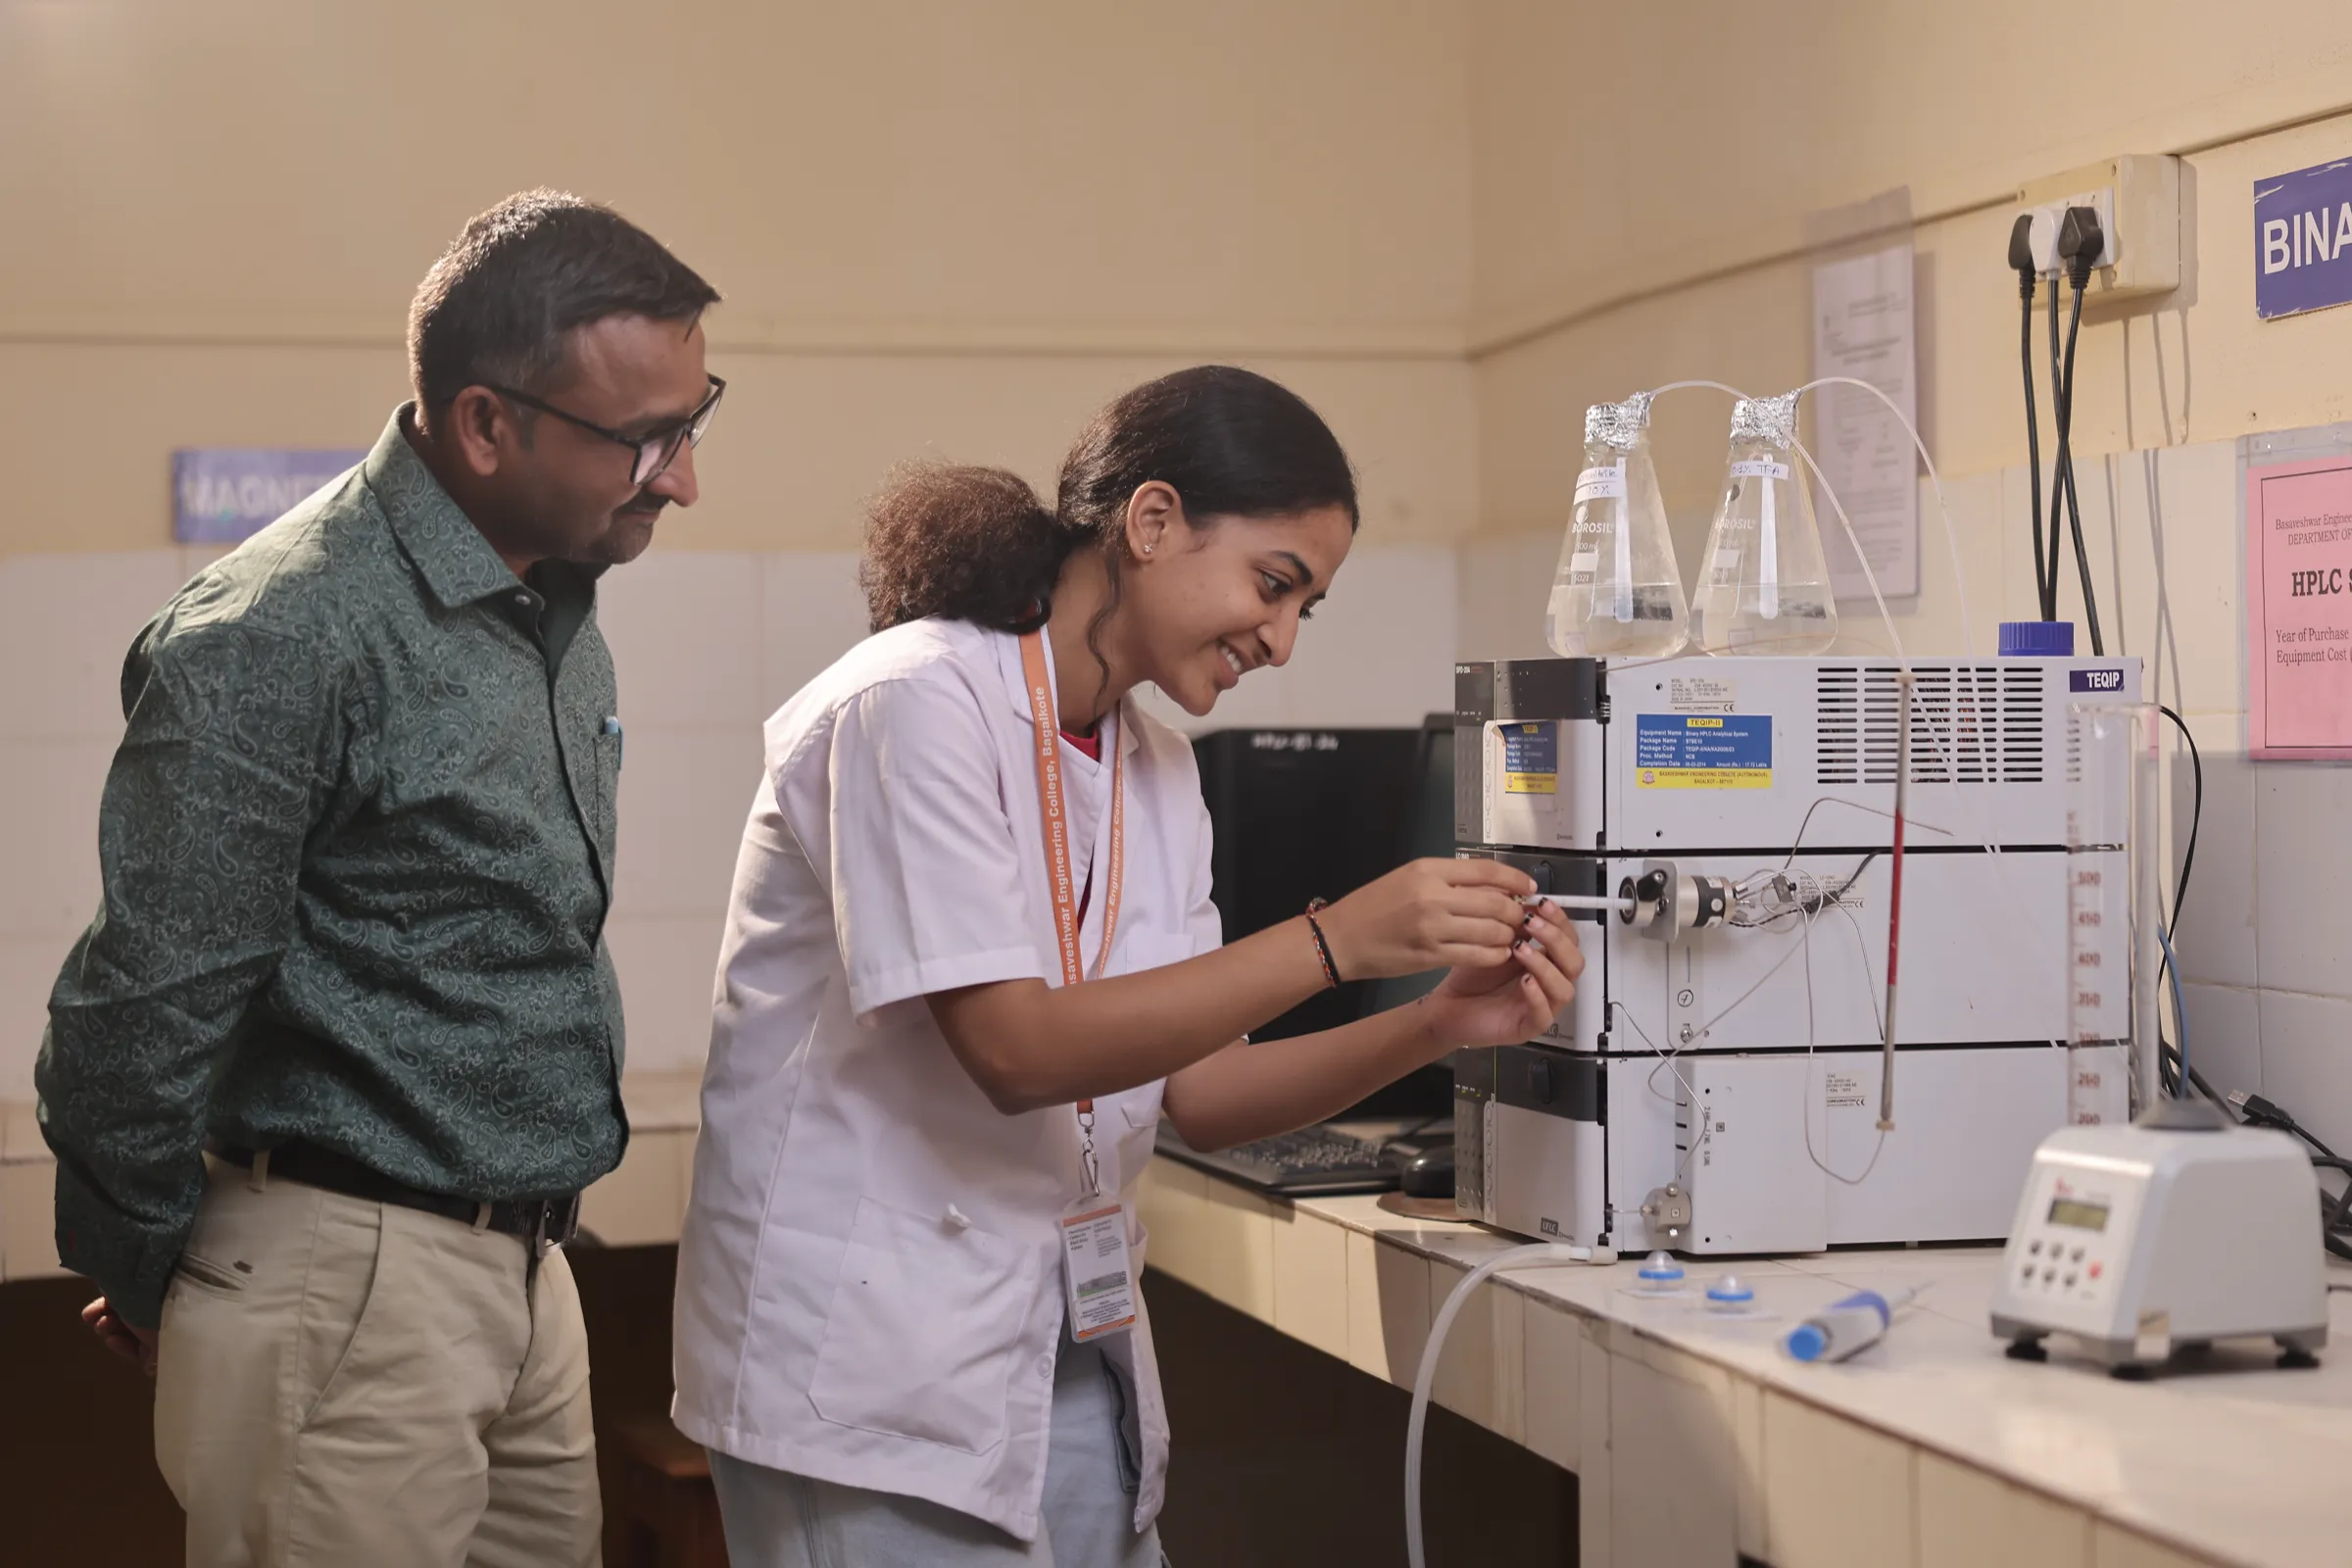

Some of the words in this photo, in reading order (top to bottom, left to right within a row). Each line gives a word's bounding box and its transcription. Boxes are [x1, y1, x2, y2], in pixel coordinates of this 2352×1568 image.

[2264, 202, 2352, 274] BINA
[1757, 464, 1780, 475] TFA
[1572, 522, 1613, 533] BOROSIL
[2276, 516, 2322, 530] Basaveshwar
[2288, 530, 2340, 546] DEPARTMENT
[2292, 568, 2342, 597] HPLC
[2277, 629, 2296, 643] Year
[2298, 627, 2307, 642] of
[2308, 626, 2349, 642] Purchase
[2277, 649, 2326, 666] Equipment
[2328, 647, 2347, 662] Cost
[2086, 671, 2120, 689] TEQIP
[1036, 687, 1054, 757] Bagalkote
[1047, 760, 1060, 817] College,
[1052, 821, 1069, 904] Engineering
[1108, 830, 1121, 906] Engineering
